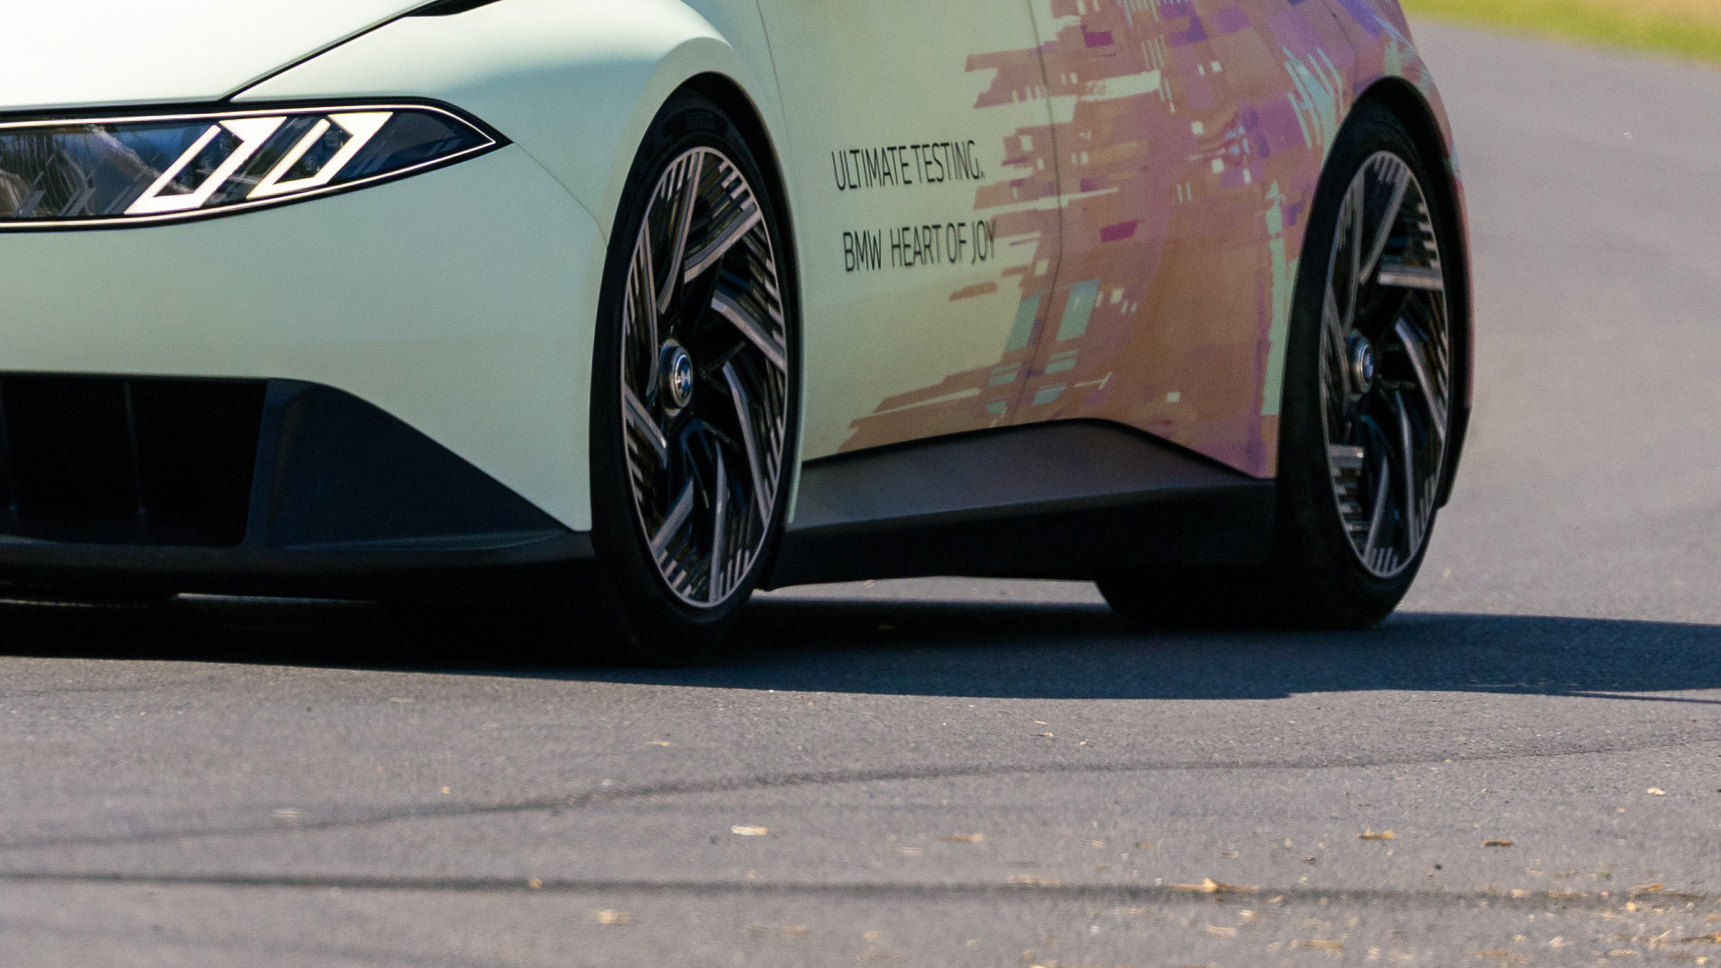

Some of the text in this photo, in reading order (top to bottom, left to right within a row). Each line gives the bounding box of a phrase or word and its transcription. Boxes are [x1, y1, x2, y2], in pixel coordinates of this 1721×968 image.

[831, 145, 913, 191] ULTIMATE
[842, 217, 997, 273] BMW HEART OF JOY
